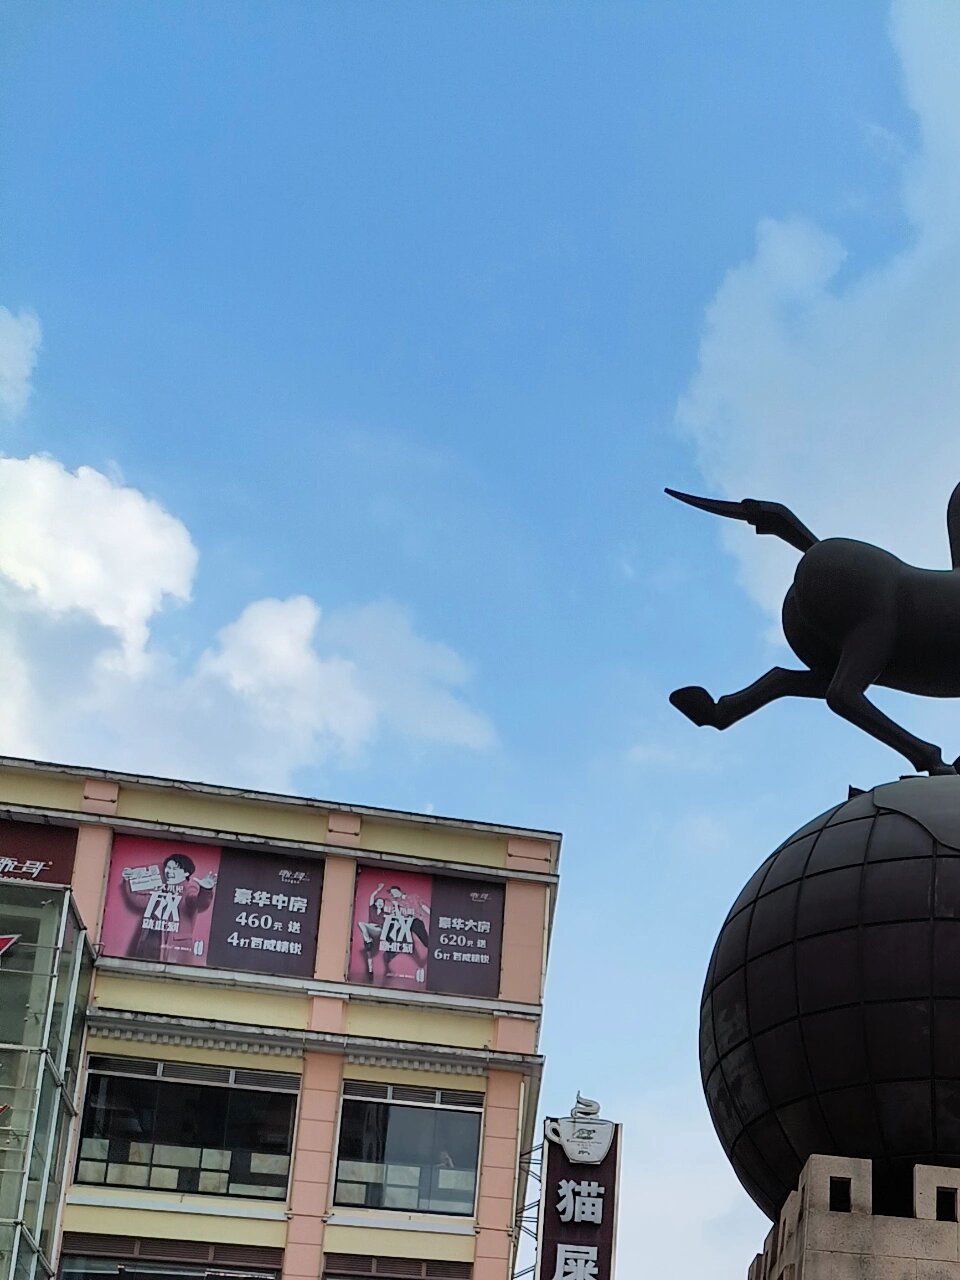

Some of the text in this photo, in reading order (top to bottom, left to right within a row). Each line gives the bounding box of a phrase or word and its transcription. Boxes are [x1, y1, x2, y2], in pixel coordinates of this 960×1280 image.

[234, 888, 308, 913] 豪华中房
[235, 911, 283, 931] 460元
